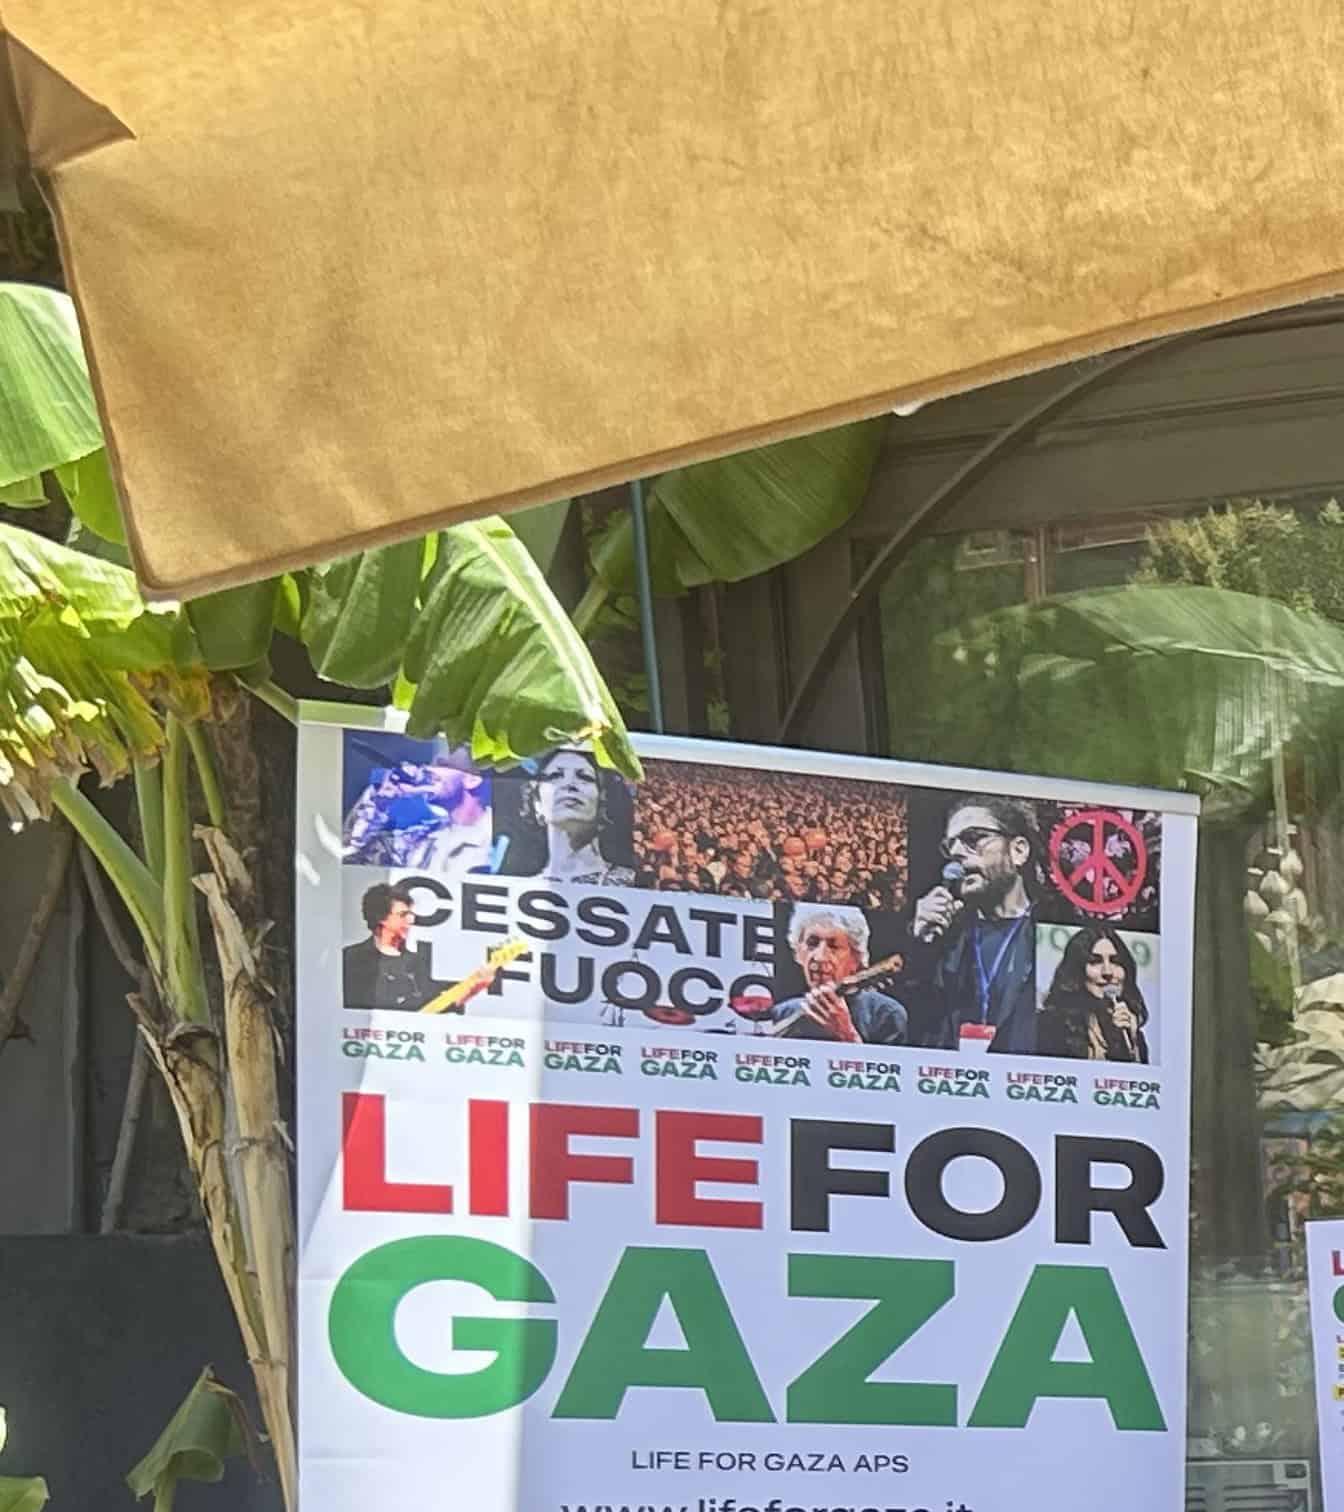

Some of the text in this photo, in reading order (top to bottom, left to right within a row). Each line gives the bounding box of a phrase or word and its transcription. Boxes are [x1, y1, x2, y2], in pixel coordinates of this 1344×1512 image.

[396, 877, 777, 961] CESSATE
[342, 1041, 426, 1063] GAZA
[445, 1047, 525, 1068] GAZA
[544, 1053, 623, 1075] GAZA
[640, 1060, 718, 1081] GAZA
[735, 1067, 811, 1087] GAZA
[827, 1072, 901, 1092] GAZA
[917, 1078, 990, 1098] GAZA
[1006, 1085, 1078, 1104] GAZA
[1094, 1090, 1160, 1110] GAZA
[341, 1093, 1168, 1249] LIFEFOR
[327, 1234, 1168, 1432] GAZA
[631, 1451, 909, 1473] LIFE FOR GAZA APS
